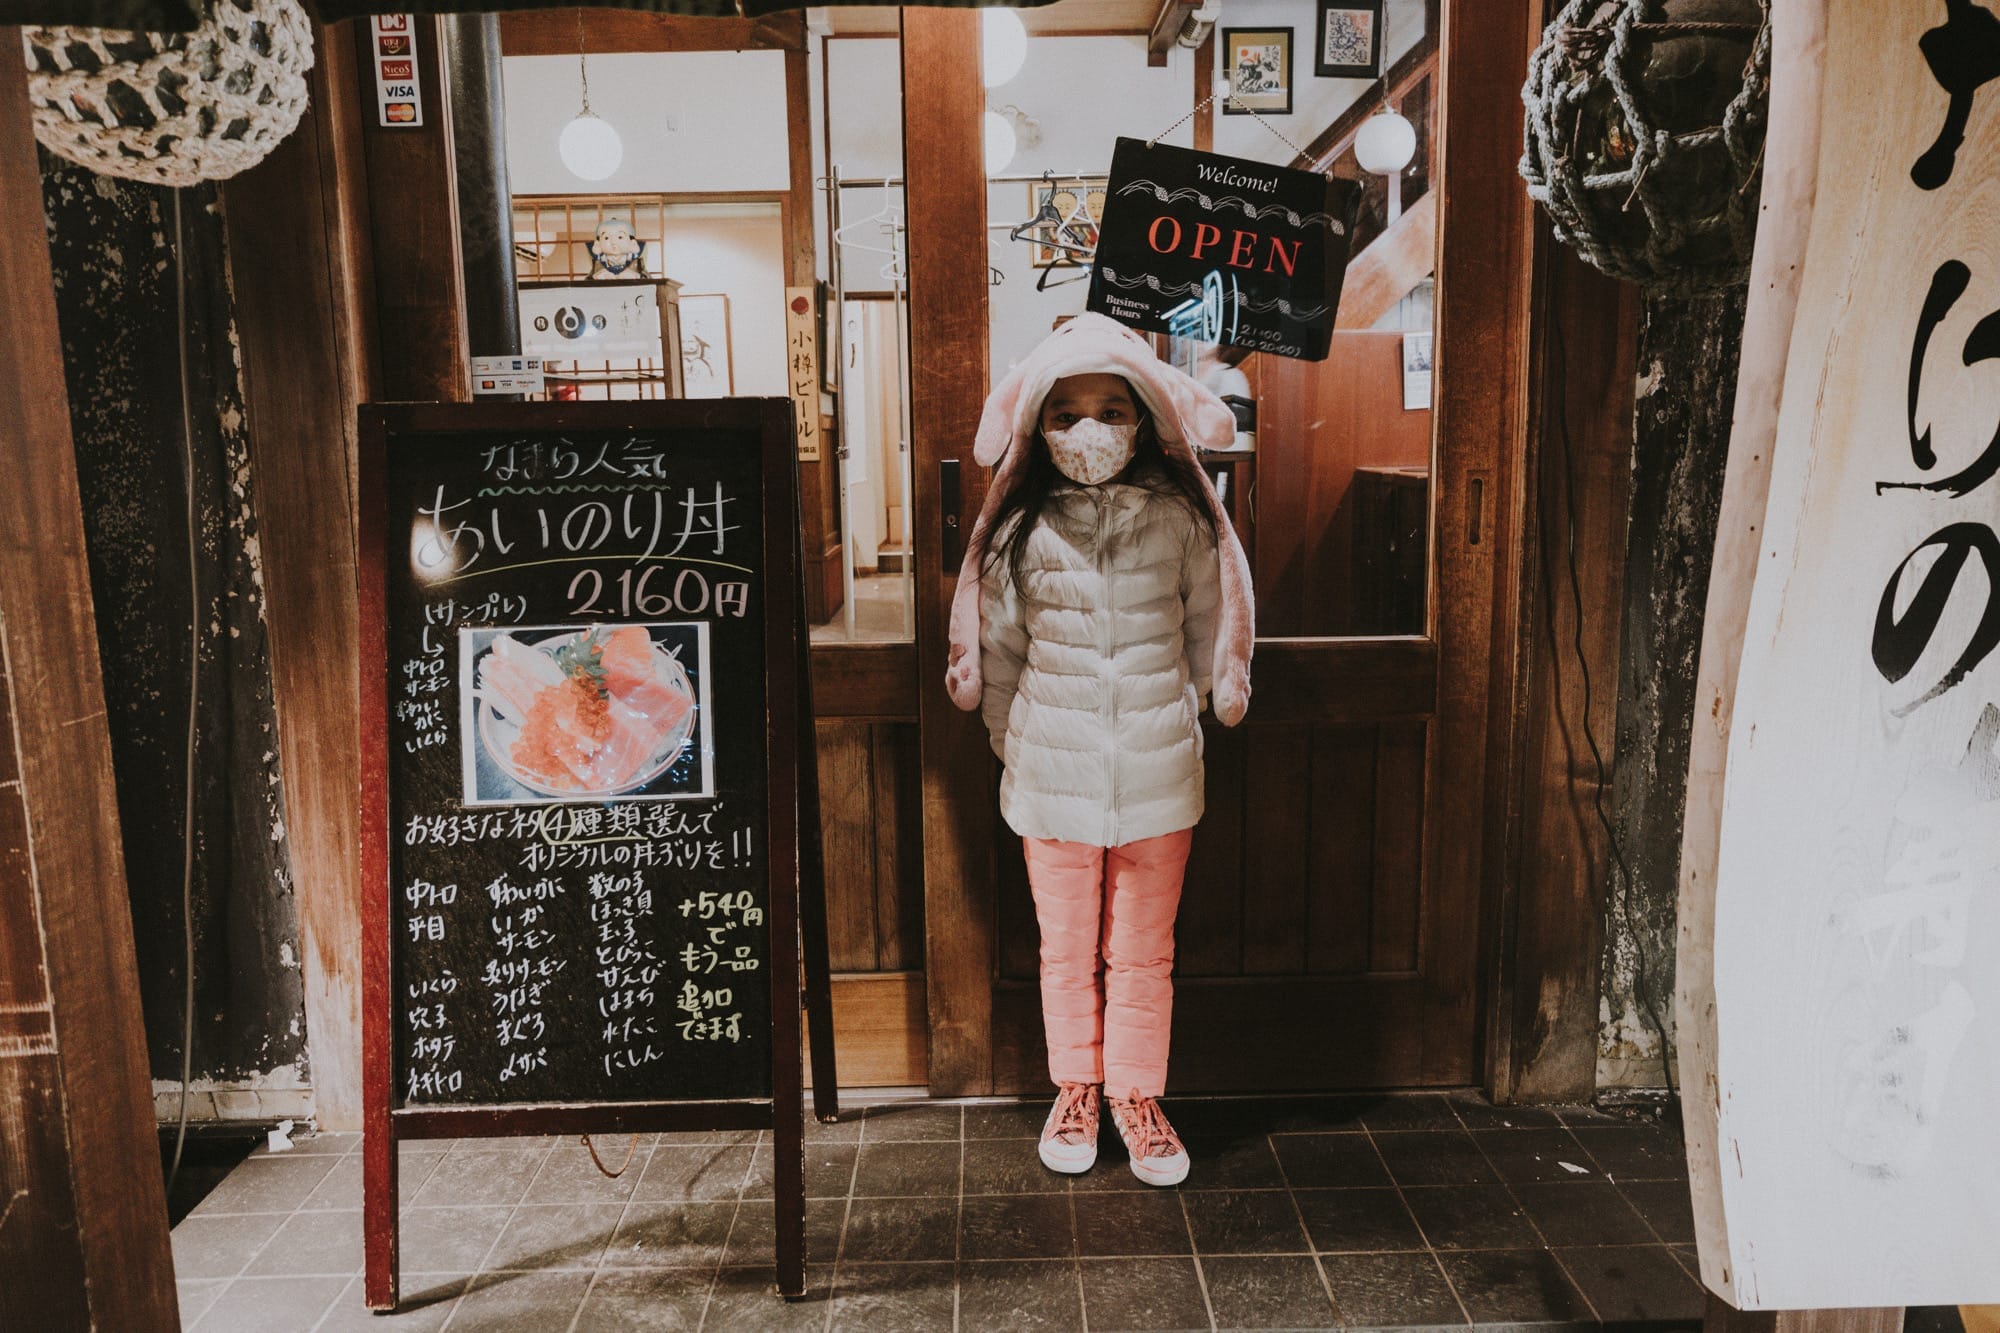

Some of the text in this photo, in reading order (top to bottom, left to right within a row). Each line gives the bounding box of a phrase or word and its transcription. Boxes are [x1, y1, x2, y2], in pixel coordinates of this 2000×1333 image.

[385, 86, 415, 97] VISA
[1197, 163, 1279, 193] Welcome!
[1147, 215, 1303, 277] OPEN
[1106, 294, 1150, 310] Business
[1111, 306, 1141, 320] Hours
[792, 330, 814, 438] 小樽ビール
[480, 437, 668, 481] なまら人気
[416, 480, 742, 572] あいのり丼
[403, 659, 445, 678] 中トロ
[405, 724, 448, 753] いくら
[406, 878, 457, 909] 中トロ
[485, 872, 566, 909] ずわいがに
[589, 871, 643, 900] 数の子
[492, 904, 544, 935] いか
[591, 890, 653, 921] ほっき貝
[408, 915, 445, 942] 平目
[497, 929, 556, 956] サーモン
[599, 918, 635, 943] 玉子
[706, 921, 737, 944] で
[679, 942, 760, 974] もう一品
[409, 970, 457, 998] いくら
[597, 960, 667, 988] 甘えび
[493, 980, 551, 1016] うなぎ
[599, 987, 654, 1017] はまち
[677, 979, 733, 1012] 追加
[409, 1004, 448, 1031] 穴子
[497, 1012, 545, 1046] まぐろ
[603, 1016, 658, 1044] 水たこ
[411, 1035, 456, 1062] ホタテ
[605, 1045, 664, 1077] にしん
[407, 1063, 462, 1100] ネギトロ
